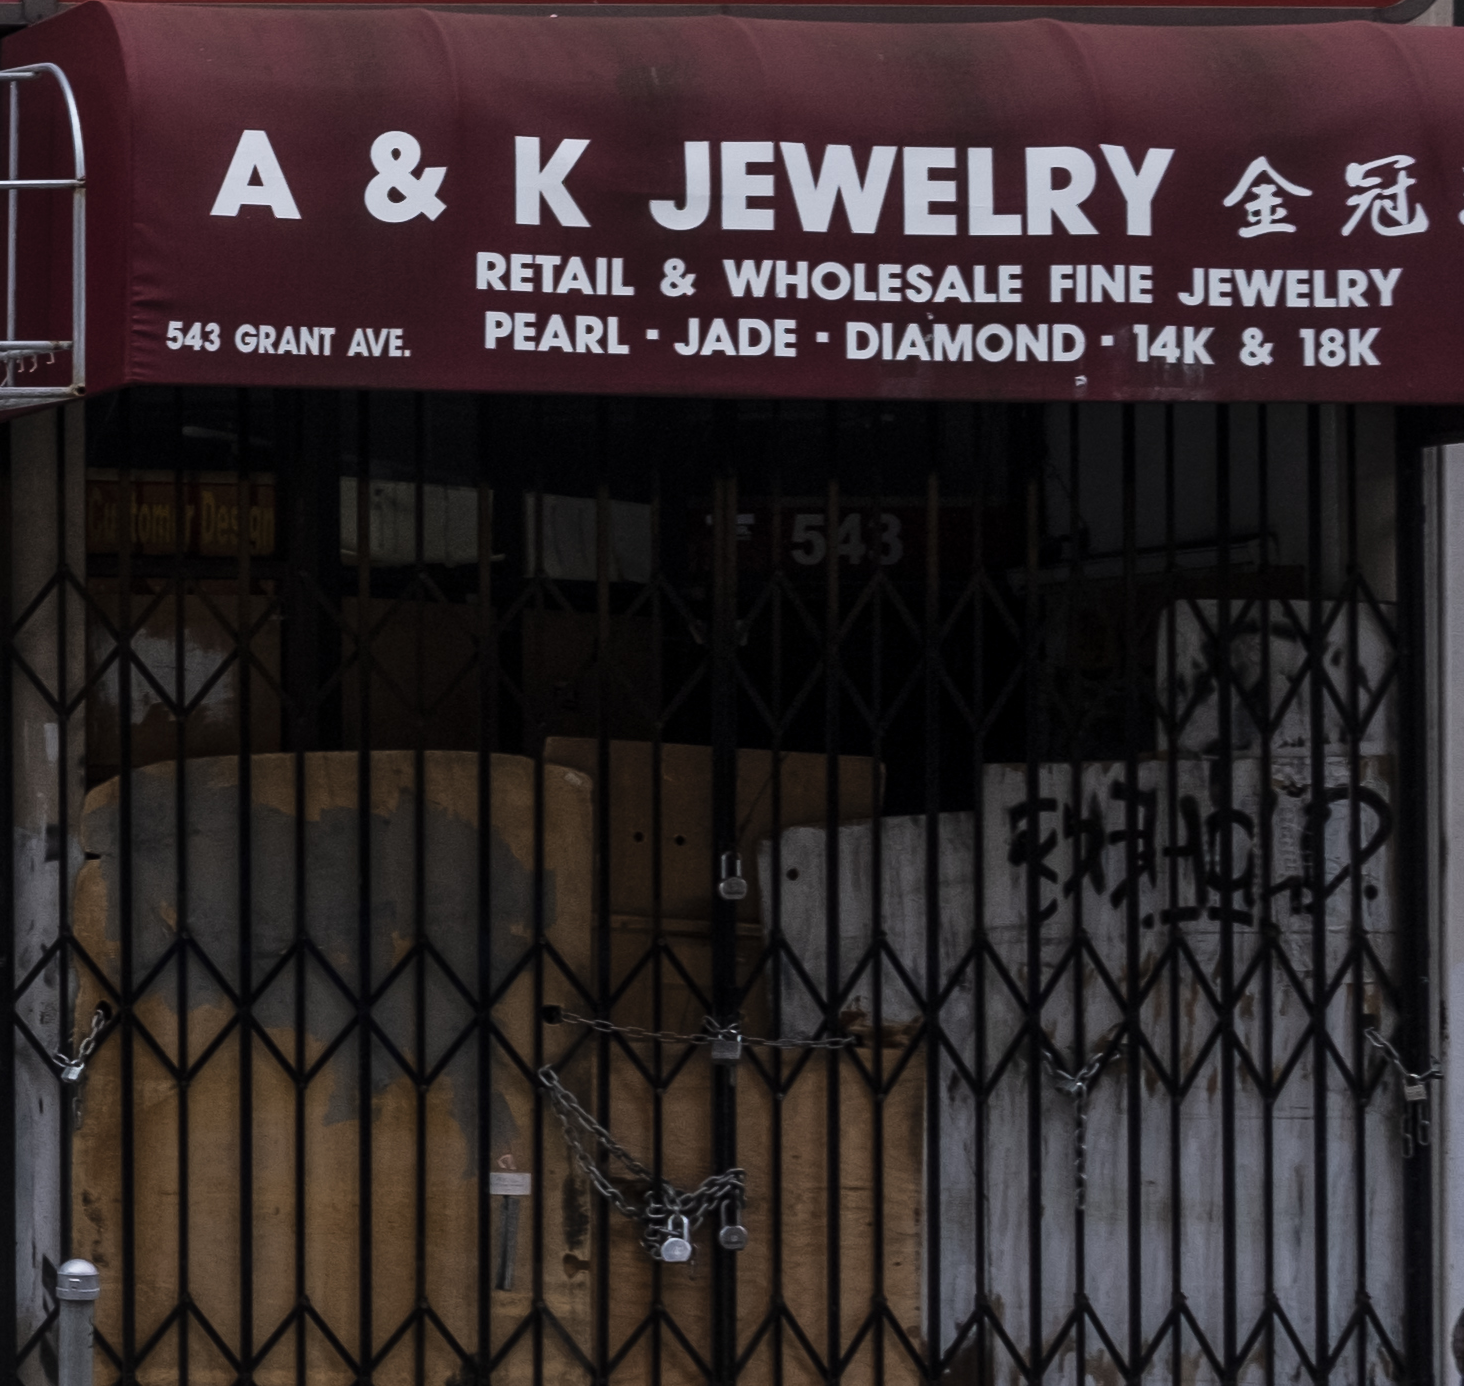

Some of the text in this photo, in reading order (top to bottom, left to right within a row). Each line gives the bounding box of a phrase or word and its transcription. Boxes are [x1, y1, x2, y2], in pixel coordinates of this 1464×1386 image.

[210, 130, 1174, 236] A & K JEWELRY
[477, 252, 1402, 307] RETAIL & WHOLESALE FINE JEWELRY
[166, 321, 410, 356] 543 GRANT AVE.
[485, 311, 1381, 367] PEARL JADE DIAMOND 14K & 18K
[790, 512, 904, 565] 543
